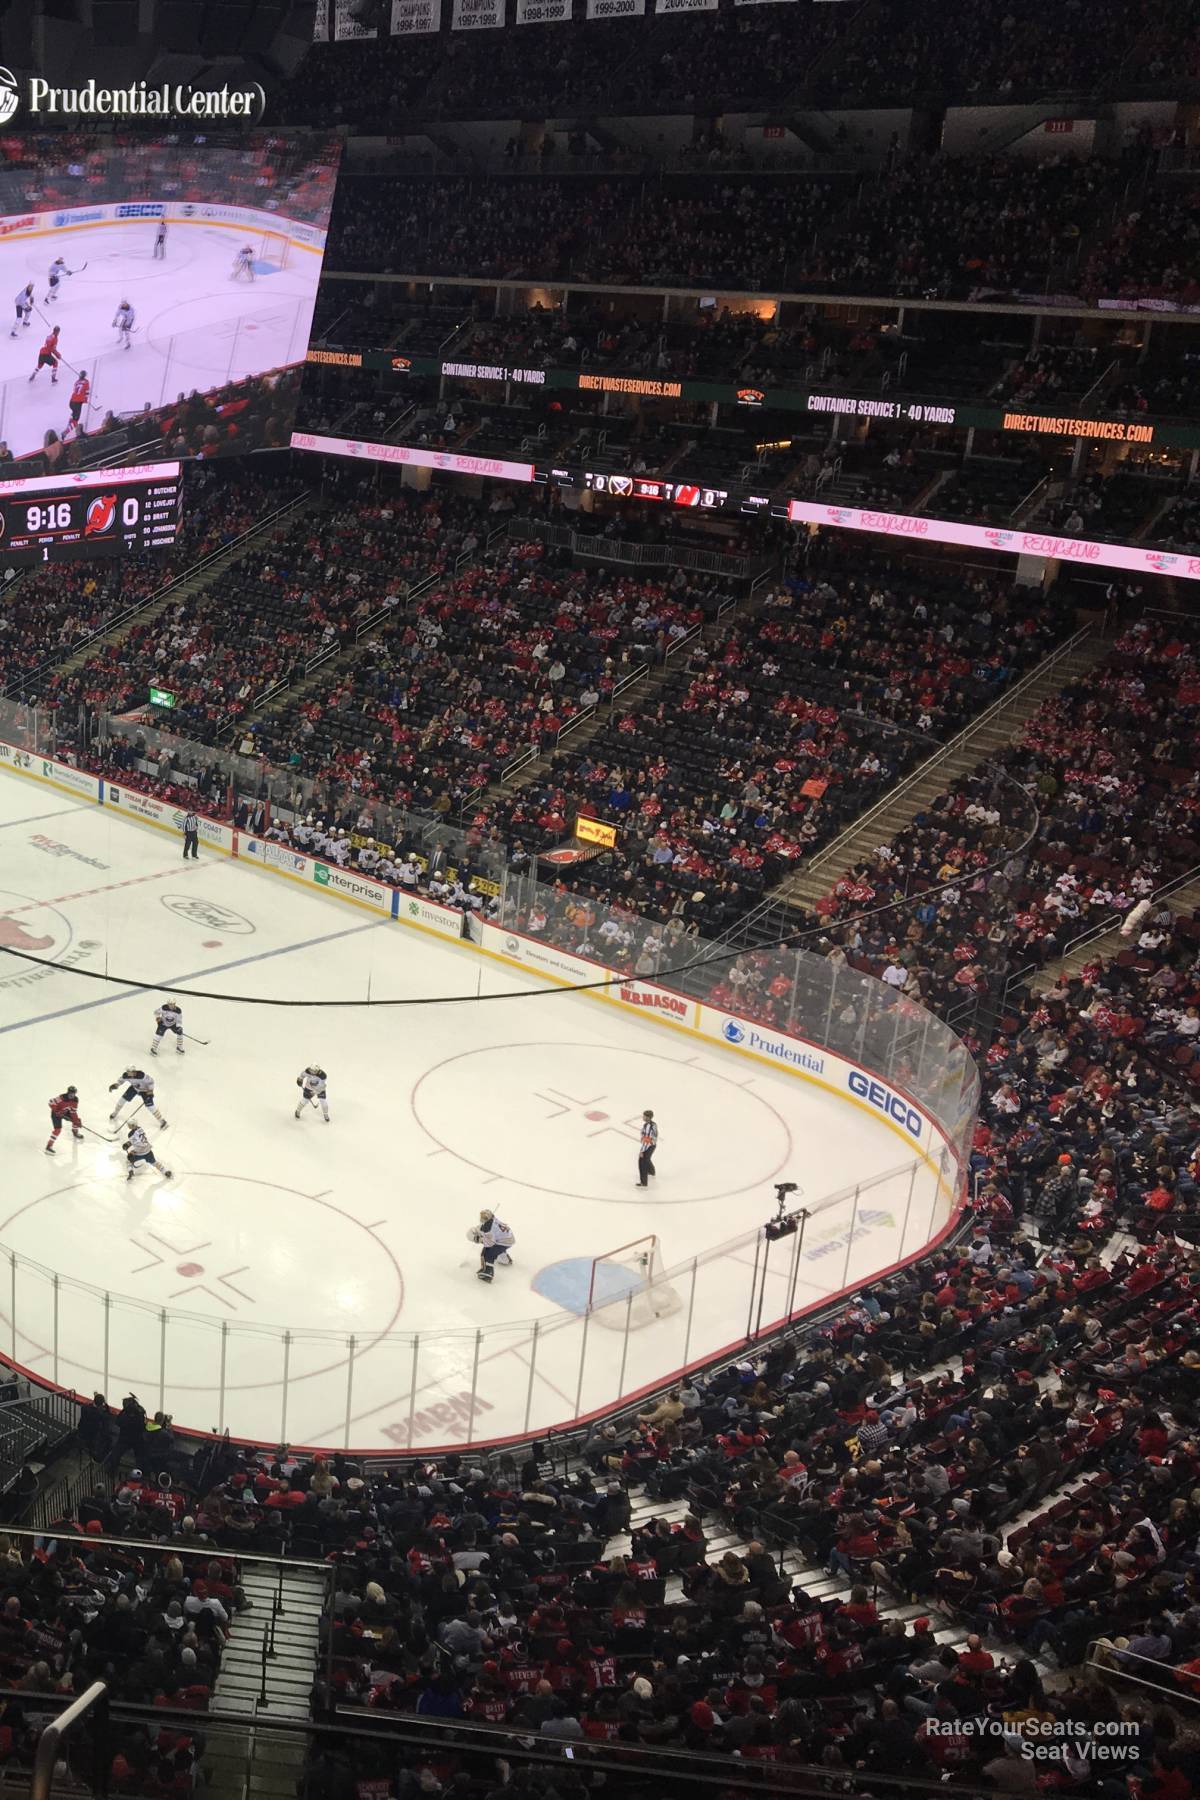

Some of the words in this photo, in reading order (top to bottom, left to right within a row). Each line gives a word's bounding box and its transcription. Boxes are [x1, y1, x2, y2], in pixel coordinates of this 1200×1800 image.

[457, 14, 497, 27] 1997-1998
[29, 78, 170, 113] Prudential
[175, 83, 256, 115] Center
[442, 363, 476, 379] CONTAINER
[477, 366, 503, 381] SERVICE
[512, 369, 522, 382] 40
[522, 370, 546, 384] YARDS
[578, 375, 681, 397] DIRECTWASTESERVICES.COM
[808, 395, 857, 414] CONTAINER
[857, 400, 894, 418] SERVICE
[896, 404, 901, 418] 1
[908, 405, 922, 421] 40
[923, 407, 955, 424] YARDS
[1003, 413, 1153, 443] DIRECTWASTESERVICES.COM
[596, 477, 604, 489] 0
[145, 501, 152, 509] 12
[706, 492, 714, 505] 0
[27, 503, 71, 532] 9:16
[123, 498, 139, 526] 0
[860, 512, 929, 534] RECYCLING
[43, 547, 49, 561] 1
[127, 542, 133, 550] 7
[1023, 535, 1101, 559] RECYCLING
[203, 822, 222, 834] COAST
[316, 869, 383, 902] enterprise
[750, 1031, 825, 1074] Prudential
[848, 1071, 922, 1138] GEICO
[379, 1391, 494, 1445] Wawa
[509, 1671, 539, 1681] STEVENS
[594, 1666, 617, 1688] 13
